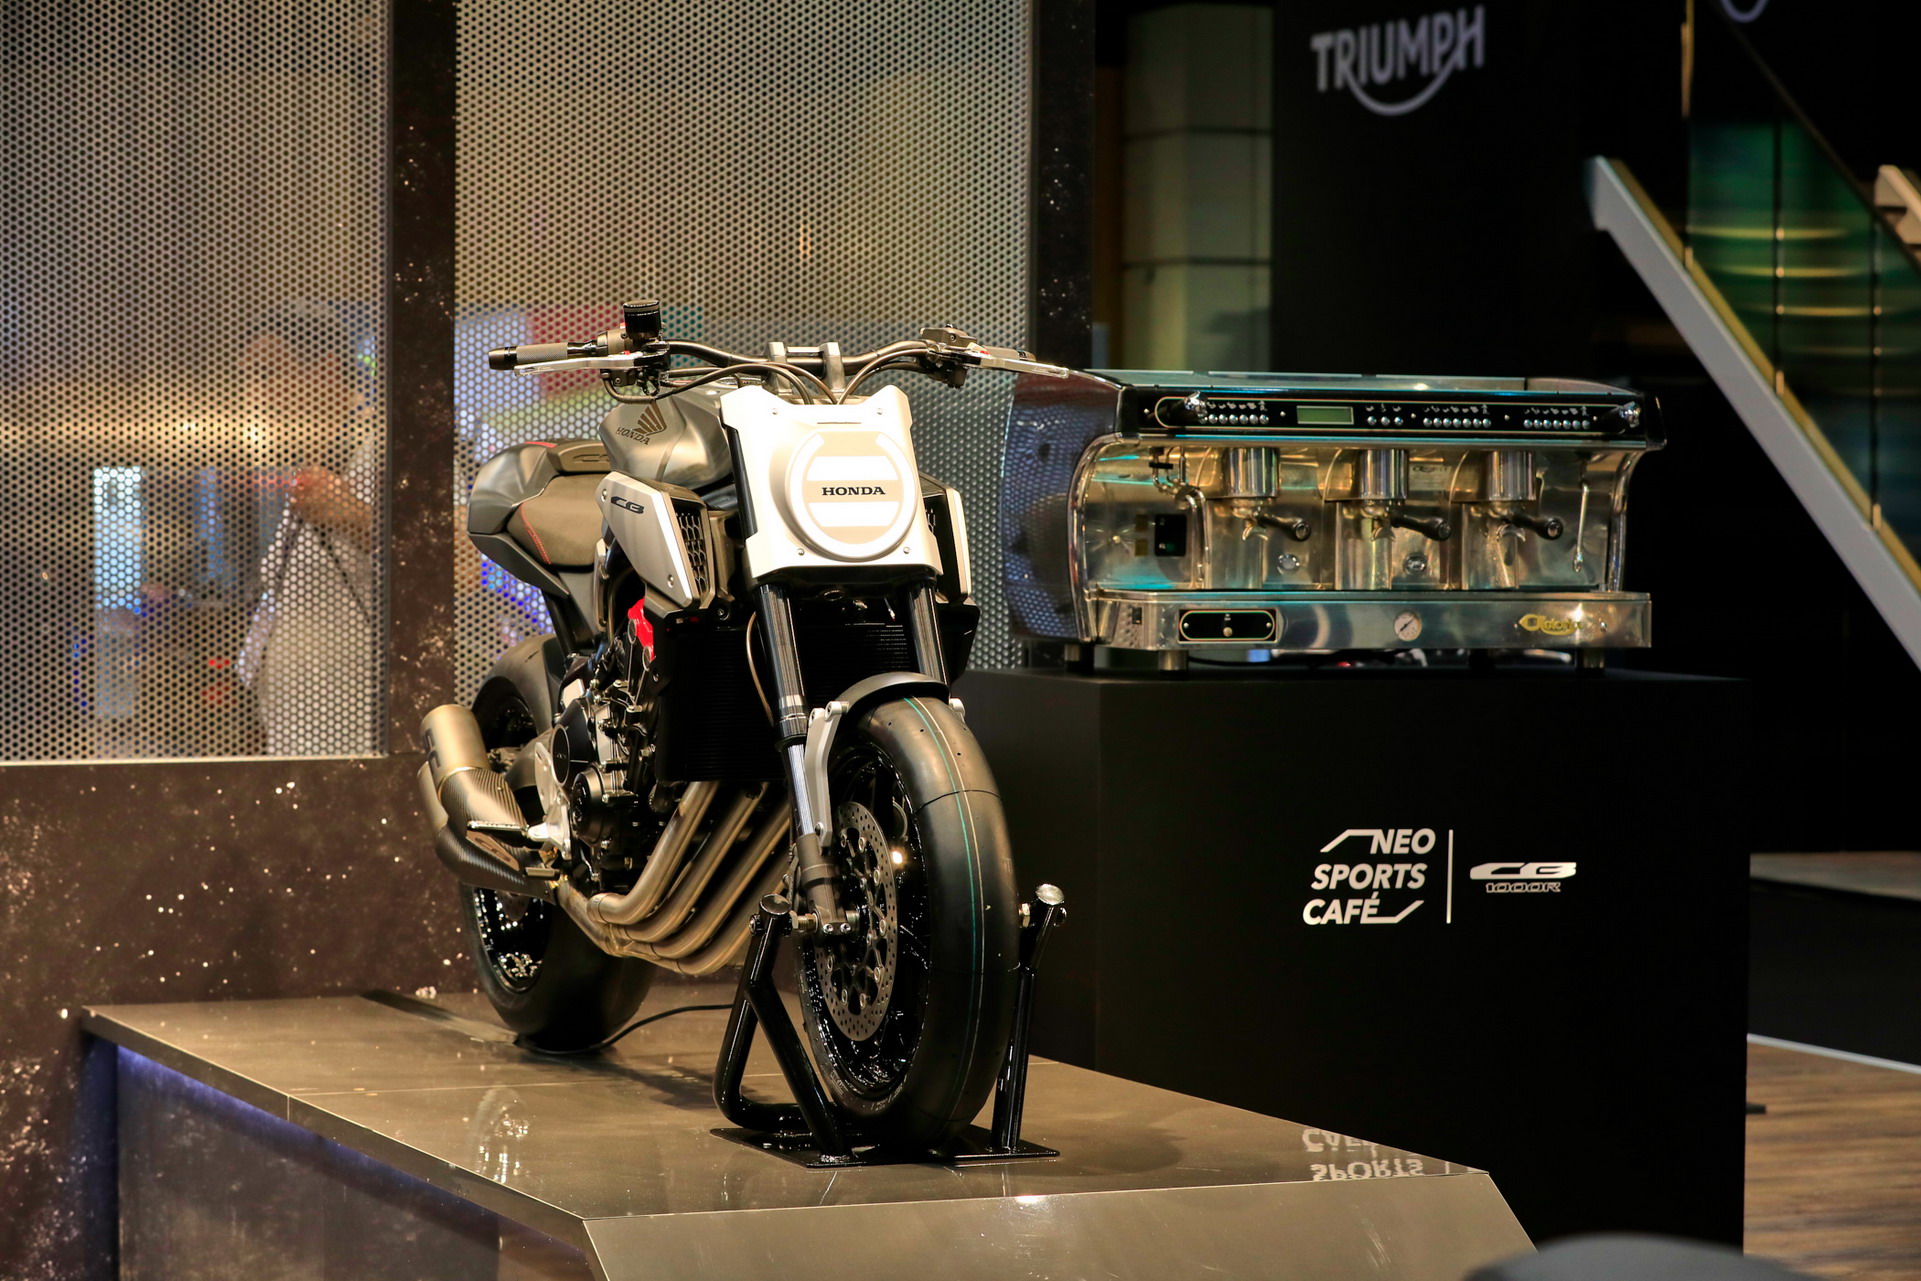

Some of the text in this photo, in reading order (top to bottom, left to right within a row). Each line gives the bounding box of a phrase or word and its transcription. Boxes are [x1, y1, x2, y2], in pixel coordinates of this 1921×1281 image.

[1310, 4, 1486, 115] TRIUMPH
[616, 425, 651, 446] HONDA
[821, 486, 886, 497] HONDA
[610, 495, 645, 514] CB
[1369, 828, 1436, 854] NEO
[1311, 863, 1428, 890] SPORTS
[1470, 862, 1577, 880] CB
[1486, 882, 1561, 893] 1000R
[1302, 892, 1381, 925] CAFÉ
